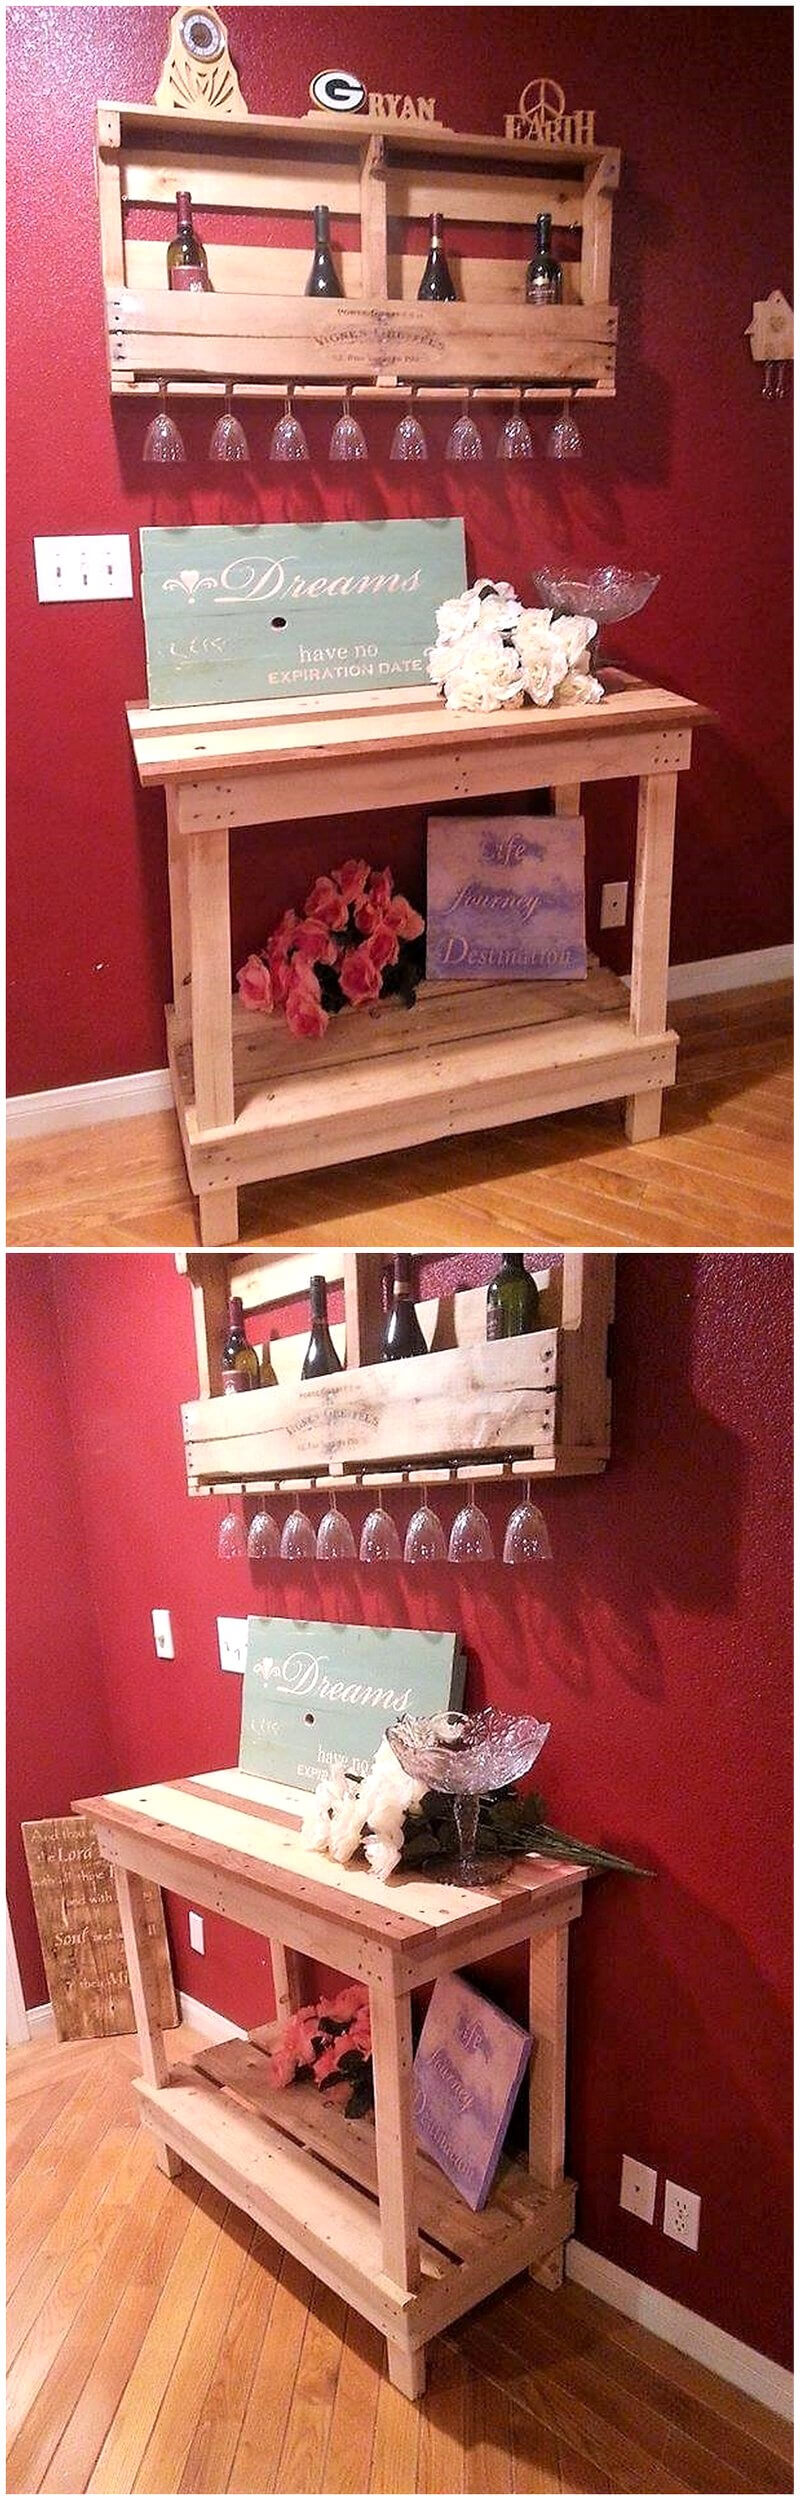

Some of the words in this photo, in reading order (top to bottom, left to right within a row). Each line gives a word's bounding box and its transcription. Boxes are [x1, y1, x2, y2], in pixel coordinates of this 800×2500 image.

[311, 71, 366, 113] G
[368, 93, 436, 122] RYAN
[504, 110, 595, 147] EARTH
[214, 555, 422, 602] Dreams
[299, 643, 348, 664] have
[354, 643, 378, 659] no
[267, 664, 374, 686] EXPIRATION
[379, 658, 422, 676] DATE
[437, 935, 575, 967] Destination
[277, 1651, 415, 1712] Dreams
[317, 1743, 349, 1769] have
[352, 1757, 370, 1775] no
[58, 1841, 96, 1862] Lord
[55, 1926, 89, 1947] Soul
